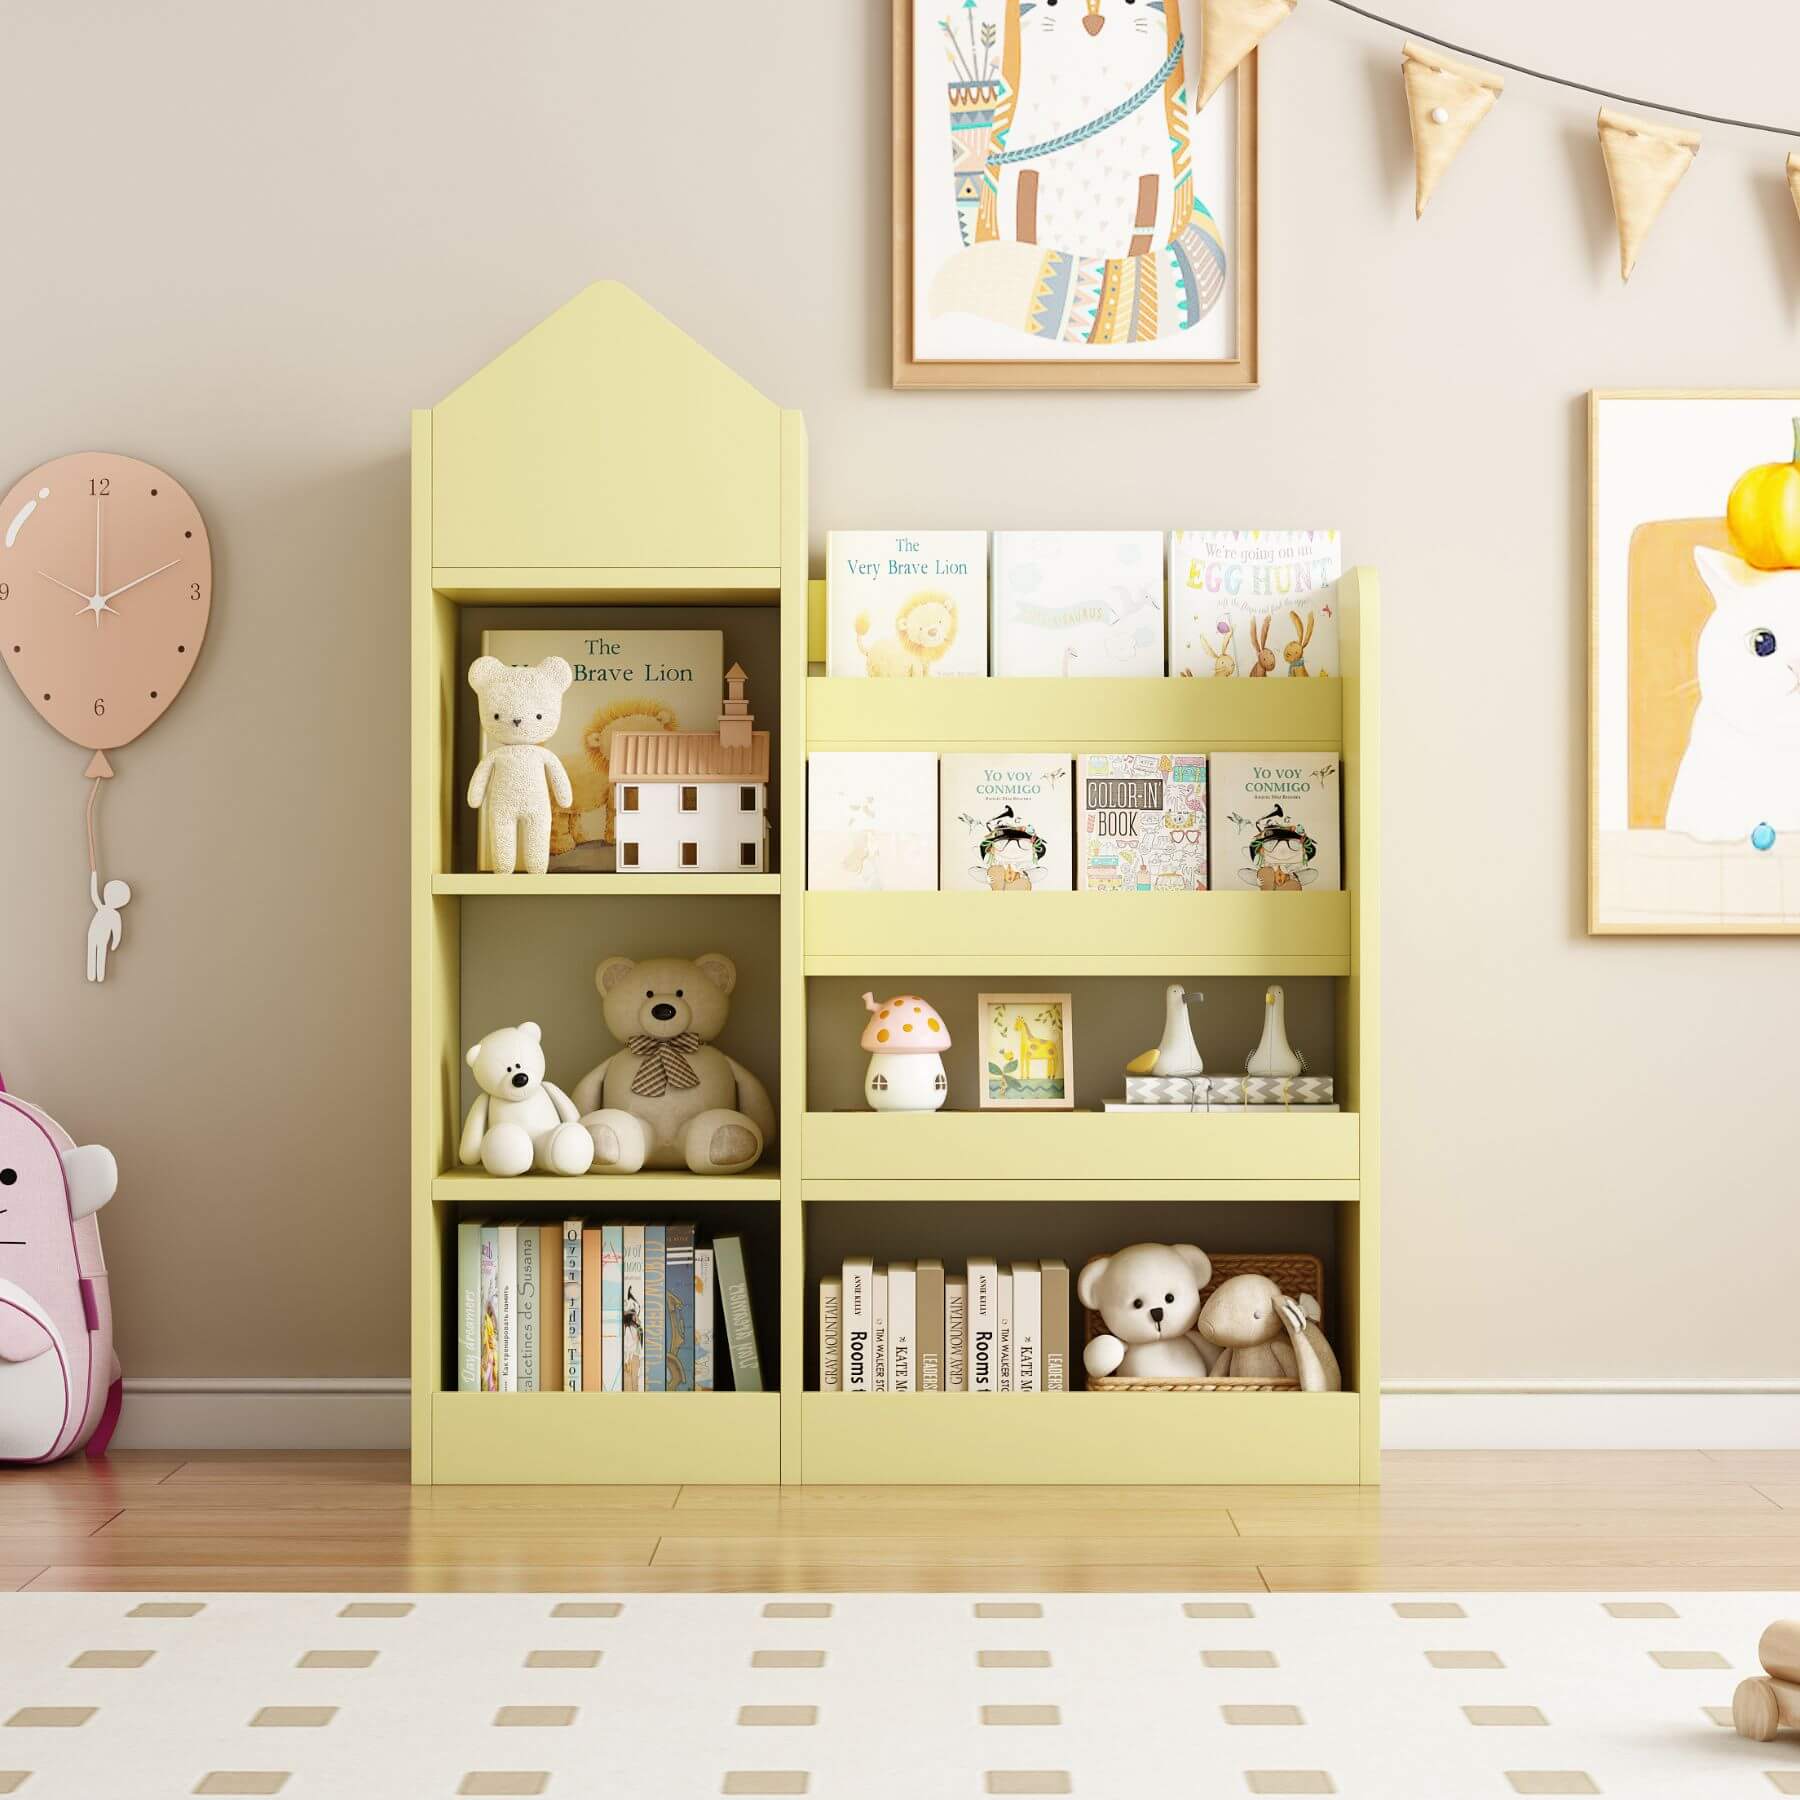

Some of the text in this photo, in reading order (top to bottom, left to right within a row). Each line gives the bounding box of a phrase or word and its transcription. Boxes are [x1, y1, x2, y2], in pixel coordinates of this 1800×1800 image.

[88, 478, 111, 497] 12
[894, 537, 921, 553] The
[1205, 543, 1237, 560] We're
[1240, 548, 1275, 563] going
[1278, 547, 1294, 559] on
[847, 558, 969, 581] Very Brave Lion
[1184, 557, 1333, 596] EGG HUNT
[190, 583, 202, 601] 3
[584, 638, 621, 656] The
[574, 664, 694, 682] Brave Lion
[94, 698, 106, 717] 6
[976, 783, 1041, 795] CONMIGO
[1245, 782, 1311, 793] CONMIGO
[1098, 811, 1139, 837] BOOK
[517, 1239, 535, 1298] Susana
[517, 1301, 533, 1320] de
[824, 1296, 838, 1386] GRAY MOUNTAIN
[876, 1328, 885, 1343] TIM
[950, 1296, 963, 1386] GRAY MOUNTAIN
[1001, 1328, 1010, 1343] TIM
[851, 1331, 868, 1384] Rooms
[876, 1344, 885, 1377] WALKER
[896, 1345, 909, 1377] KATE
[976, 1331, 993, 1384] Rooms
[1001, 1344, 1010, 1377] WALKER
[1020, 1345, 1033, 1377] KATE
